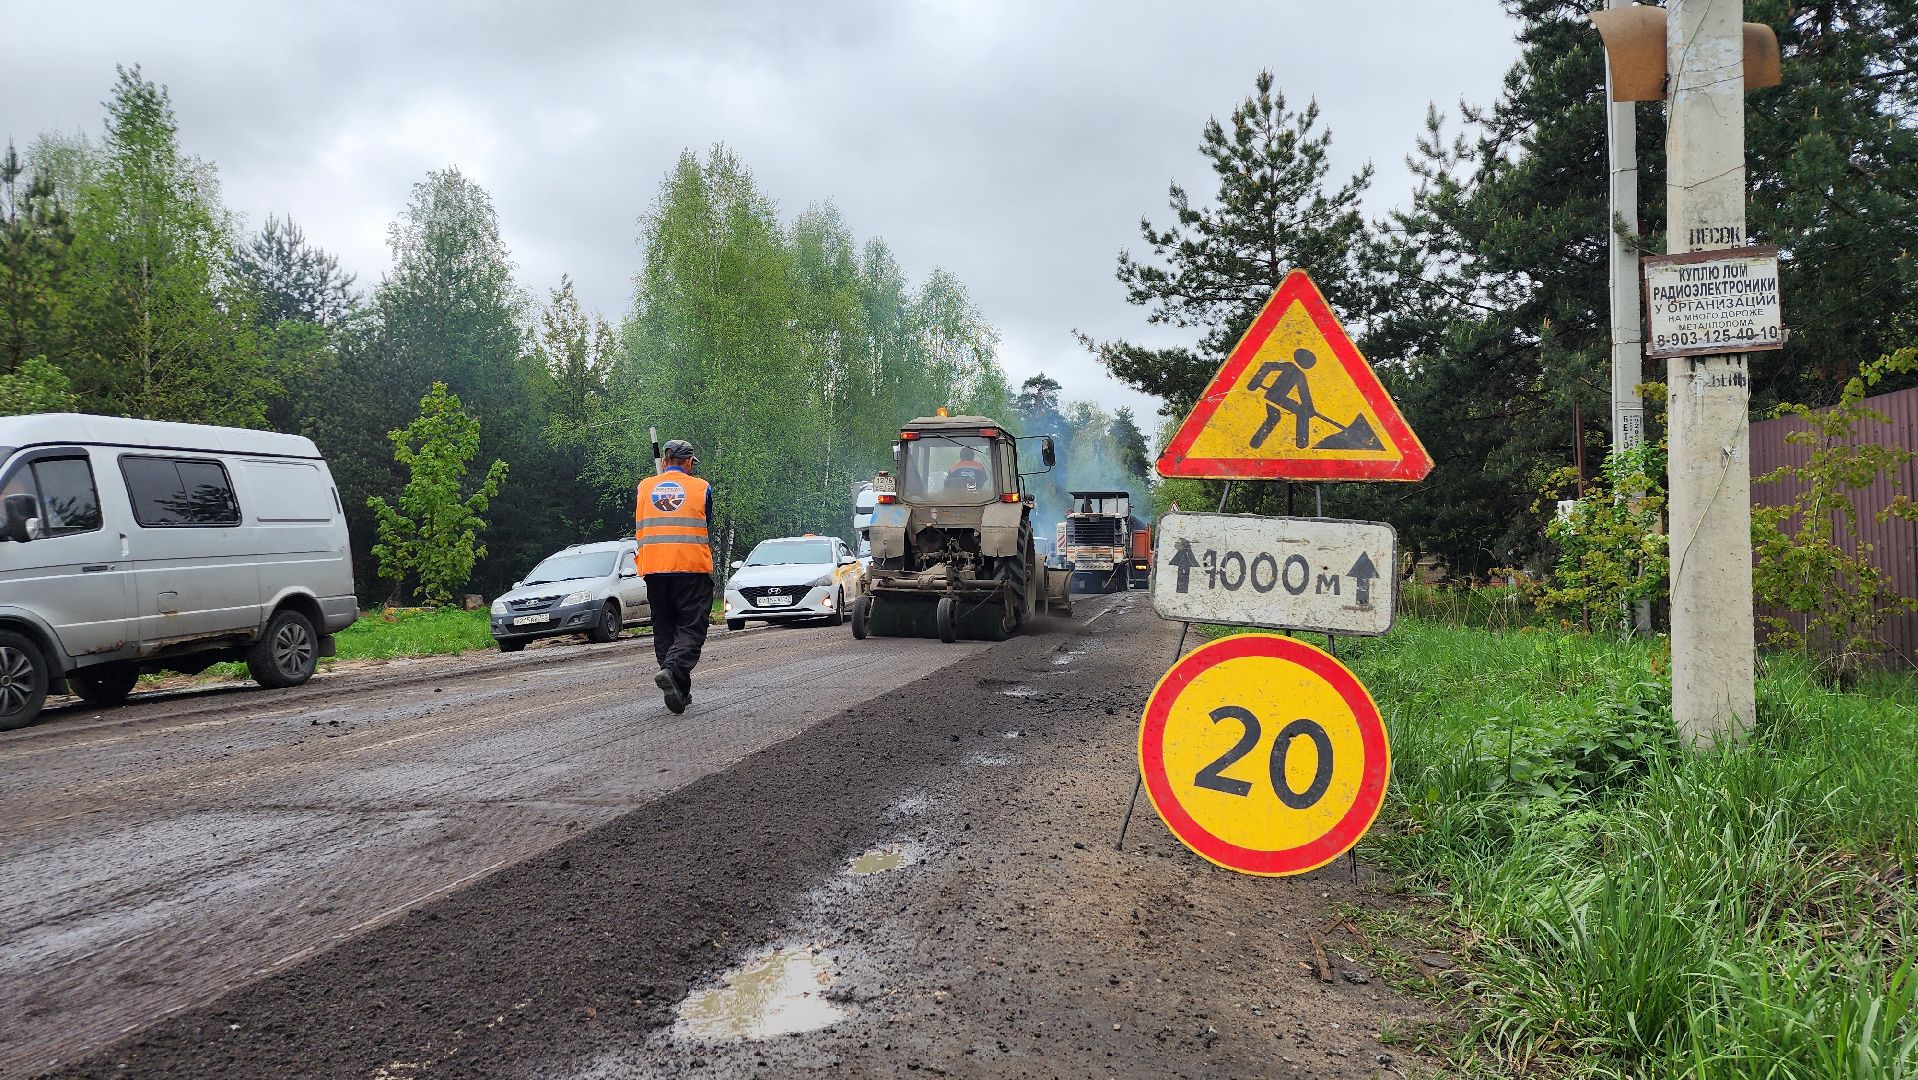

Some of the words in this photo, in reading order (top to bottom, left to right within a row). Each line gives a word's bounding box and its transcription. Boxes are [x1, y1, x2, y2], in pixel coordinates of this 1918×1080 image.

[1689, 226, 1741, 245] ПЕСОК
[1679, 265, 1720, 282] КУПЛЮ
[1722, 264, 1748, 279] ЛОМ
[1653, 278, 1776, 302] РАДИОЭЛЕКТРОНИКИ
[1655, 304, 1662, 314] У
[1684, 312, 1719, 321] МНОГО
[1720, 308, 1764, 319] ДОРОЖЕ
[1679, 319, 1754, 331] МЕТАЛЛОЛОМА
[1657, 326, 1778, 347] 8-903-125-40-10
[1193, 705, 1334, 810] 20
